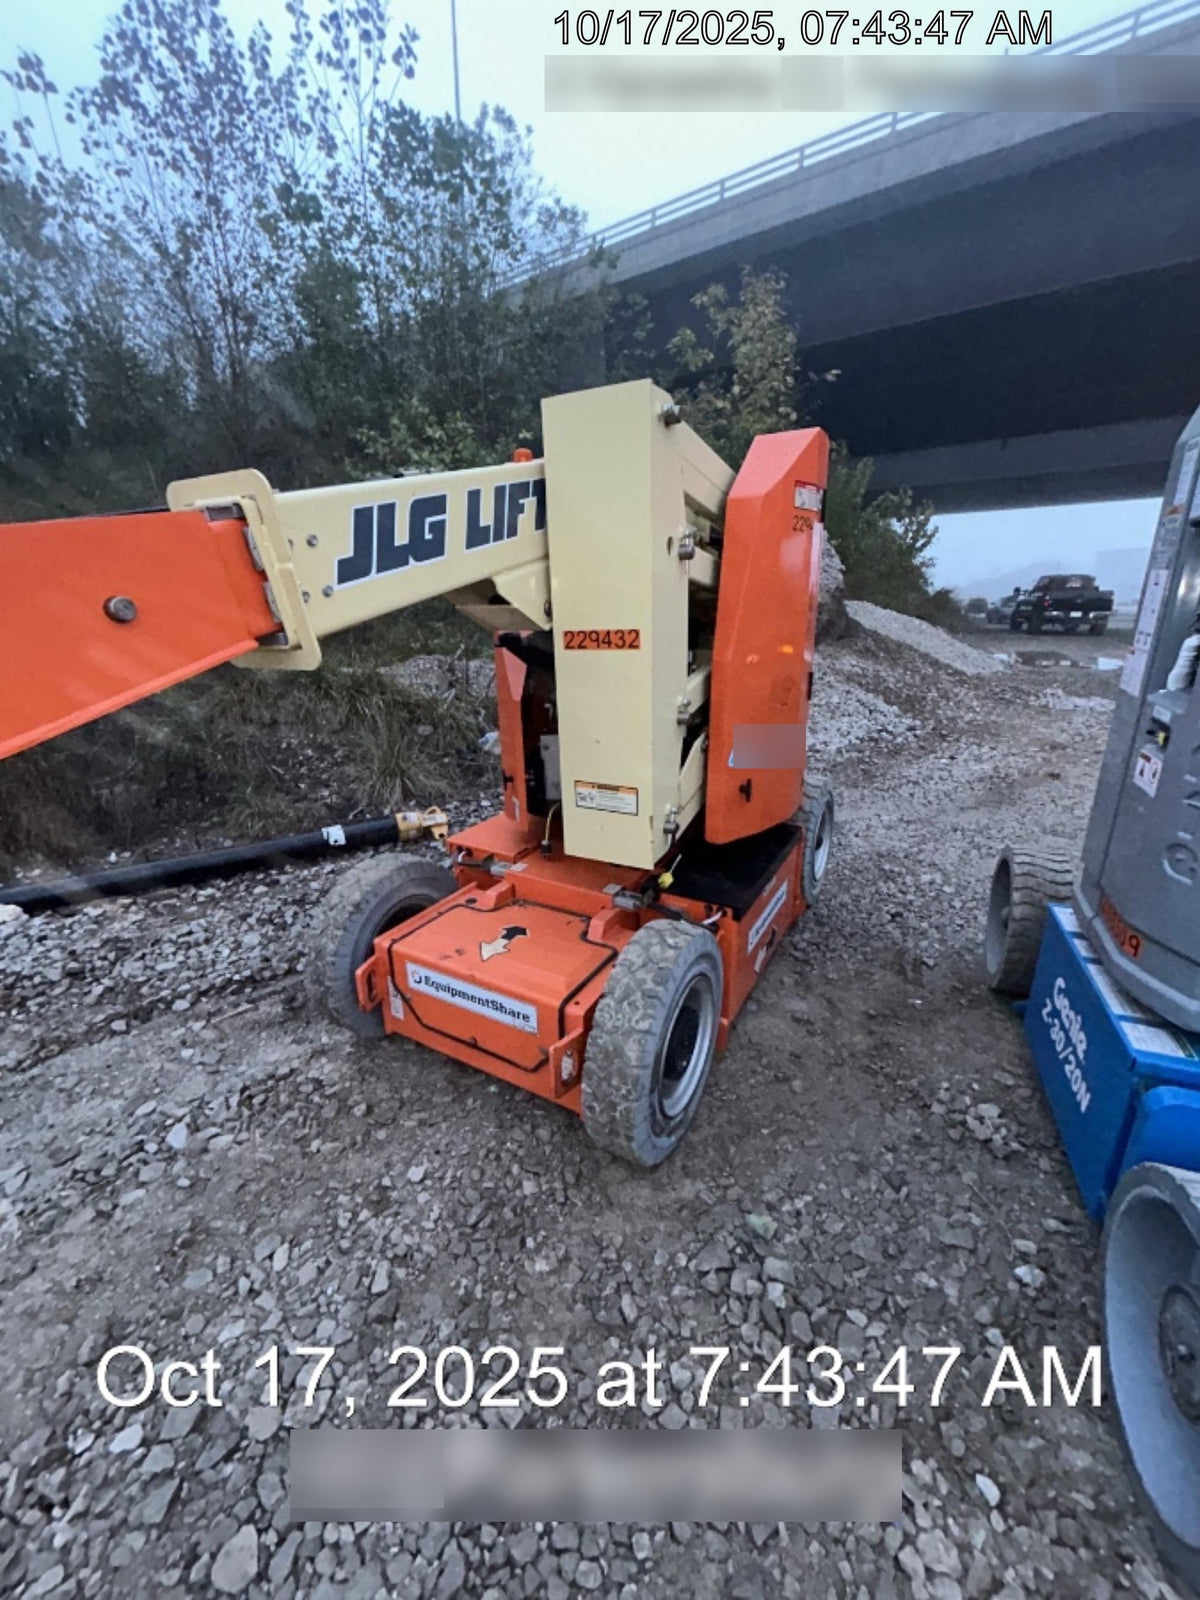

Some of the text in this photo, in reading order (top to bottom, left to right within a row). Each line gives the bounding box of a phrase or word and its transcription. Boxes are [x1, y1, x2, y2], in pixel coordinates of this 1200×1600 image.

[336, 477, 546, 586] JLG LIFT
[564, 628, 640, 650] 229432
[423, 974, 532, 1024] EquipmentShare
